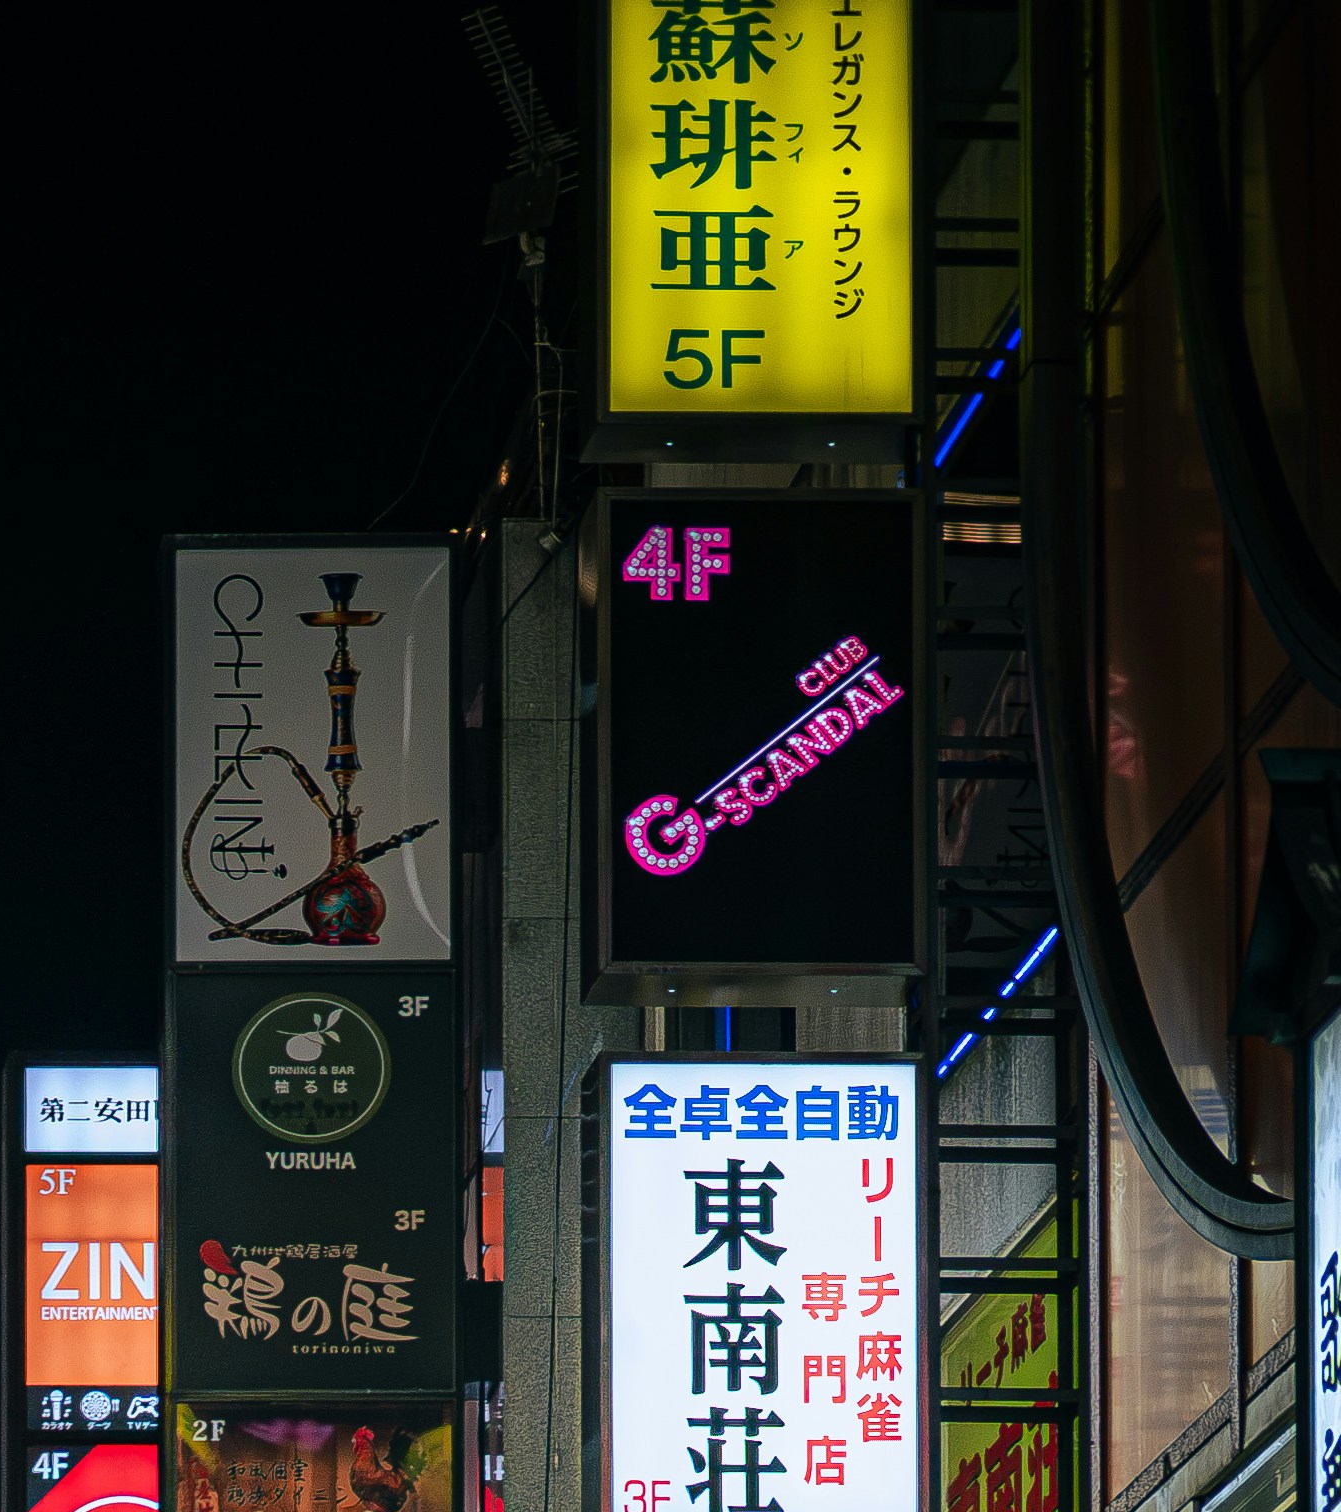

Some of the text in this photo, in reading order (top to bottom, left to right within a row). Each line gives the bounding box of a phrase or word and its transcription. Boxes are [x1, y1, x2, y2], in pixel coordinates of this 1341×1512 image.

[663, 329, 767, 390] 5F
[623, 526, 731, 601] 4F
[796, 636, 870, 698] CLUB
[625, 672, 905, 876] G-SCANDAL
[397, 995, 430, 1019] 3F
[331, 1065, 355, 1076] BAR
[39, 1097, 158, 1125] 第二安田
[623, 1083, 900, 1143] 全卓全自動
[39, 1169, 76, 1196] 5F
[265, 1151, 357, 1171] YURUHA
[394, 1210, 426, 1232] 3F
[41, 1242, 156, 1300] ZIN
[203, 1258, 421, 1343] 鶏の庭
[855, 1157, 903, 1444] リーチ麻雀
[801, 1271, 848, 1487] 専門店
[41, 1421, 74, 1431] カラオケ
[191, 1419, 226, 1442] 2F
[31, 1452, 70, 1480] 4F
